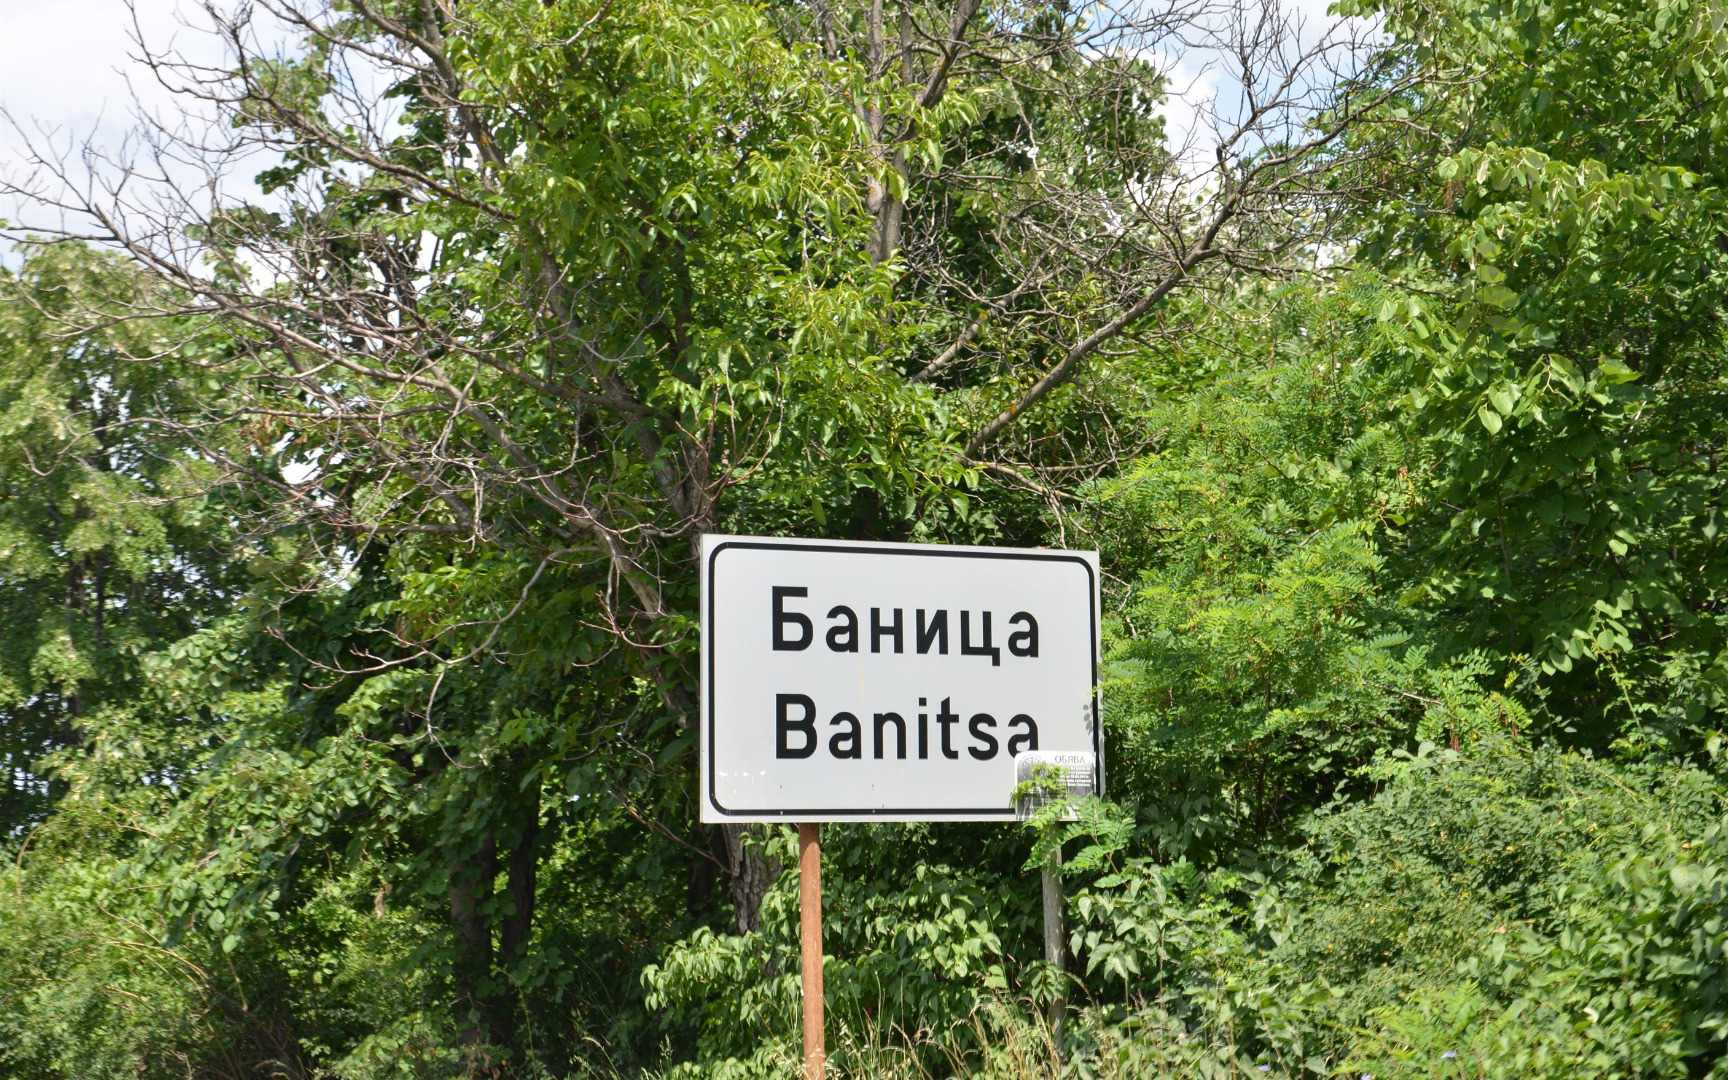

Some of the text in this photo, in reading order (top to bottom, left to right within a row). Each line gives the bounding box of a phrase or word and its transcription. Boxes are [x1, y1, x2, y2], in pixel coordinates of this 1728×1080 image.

[771, 585, 1039, 667] Баница
[775, 693, 1039, 761] Banitsa
[1054, 755, 1085, 764] ОБЯВА
